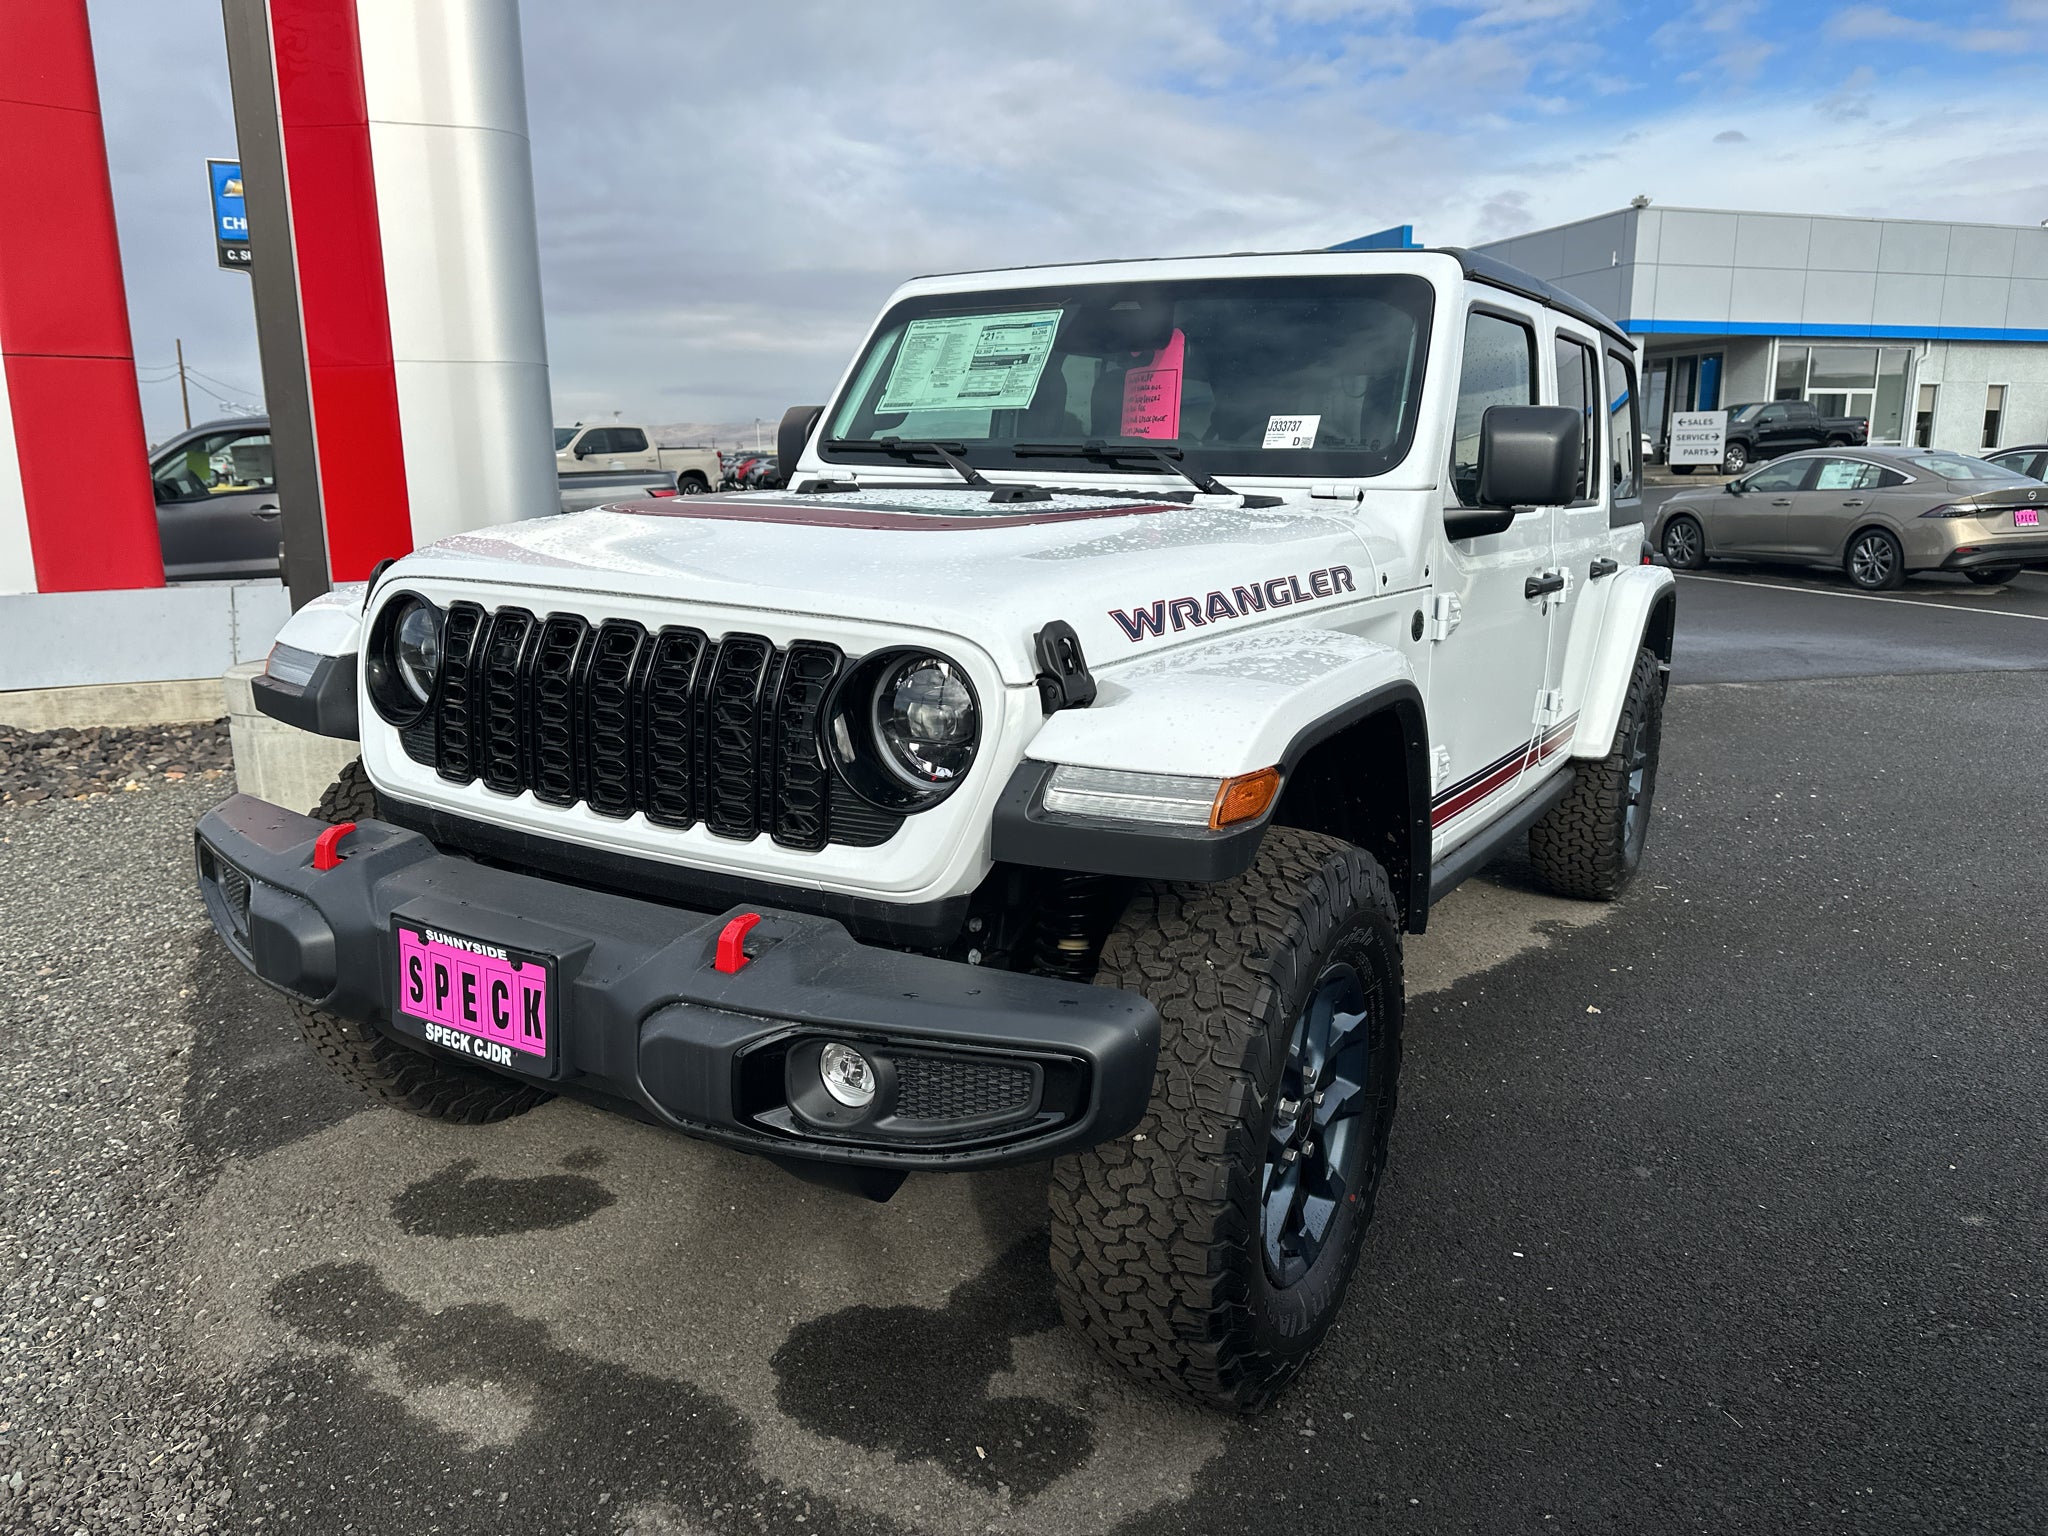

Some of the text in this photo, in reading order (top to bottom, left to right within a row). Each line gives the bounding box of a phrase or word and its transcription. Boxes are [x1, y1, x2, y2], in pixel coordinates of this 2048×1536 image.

[984, 332, 995, 341] 21
[1267, 420, 1303, 432] J333737
[1687, 418, 1714, 426] SALES
[1292, 436, 1301, 446] D
[1676, 433, 1711, 441] SERVICE
[1683, 448, 1709, 456] PARTS
[1108, 565, 1356, 642] WRANGLER
[425, 929, 509, 961] SUNNYSIDE
[409, 955, 543, 1040] SPECK
[425, 1022, 512, 1067] SPECK CJDR
